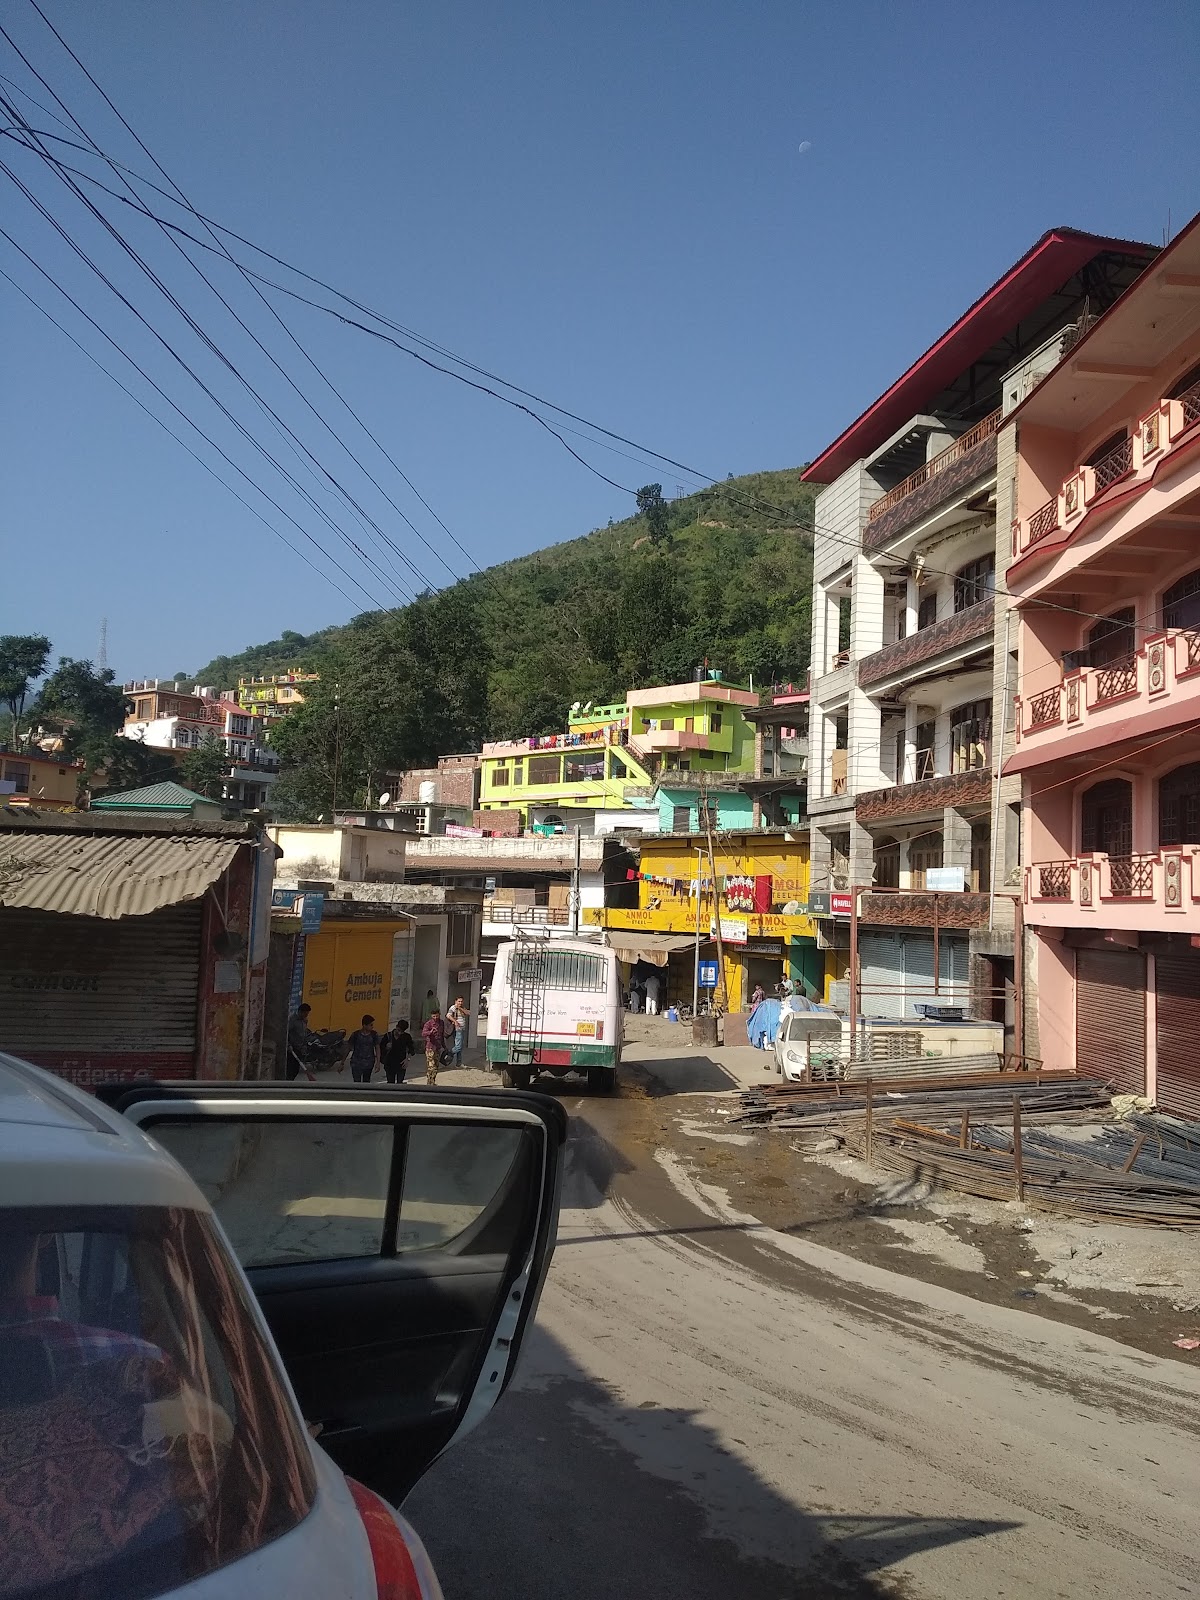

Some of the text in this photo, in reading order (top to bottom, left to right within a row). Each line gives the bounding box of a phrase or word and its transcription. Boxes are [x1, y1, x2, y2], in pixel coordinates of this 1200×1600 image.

[625, 911, 653, 920] ANMOL
[750, 916, 787, 926] ANMOL
[346, 972, 383, 987] Ambuja
[344, 987, 382, 1003] Cement
